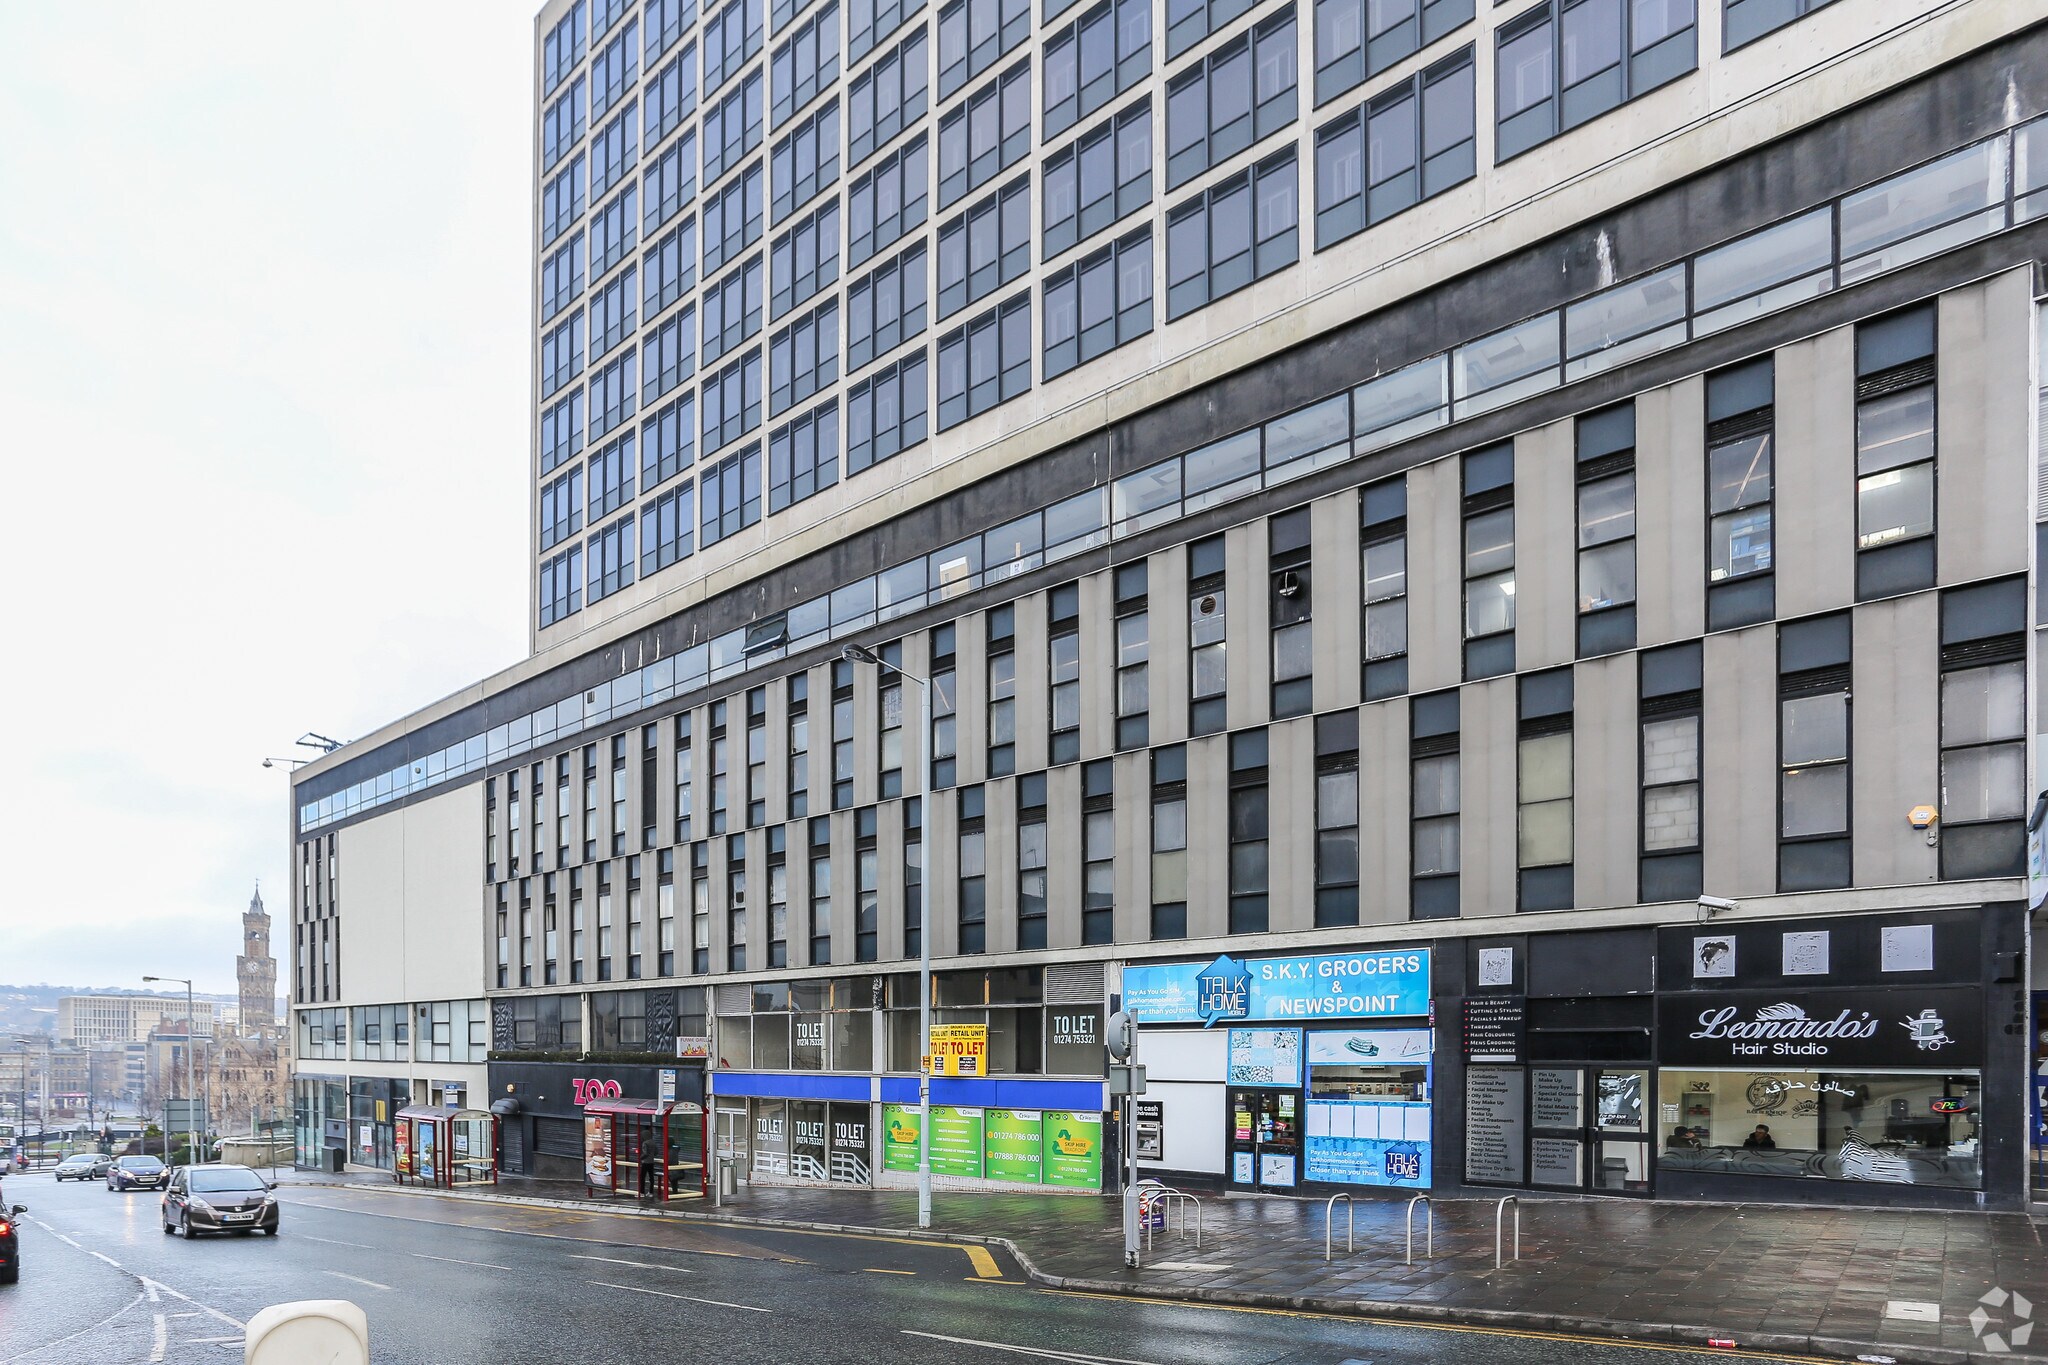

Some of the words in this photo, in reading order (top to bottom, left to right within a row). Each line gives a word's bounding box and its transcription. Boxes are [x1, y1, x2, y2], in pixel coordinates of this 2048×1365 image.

[1262, 963, 1312, 980] S.K.Y.
[1318, 956, 1420, 977] GROCERS
[1202, 976, 1246, 993] TALK
[1331, 981, 1342, 993] &
[1201, 993, 1246, 1010] HOME
[1280, 995, 1399, 1015] NEWSPOINT
[1164, 1009, 1177, 1017] you
[1054, 1016, 1070, 1034] TO
[1073, 1016, 1095, 1034] LET
[1690, 1006, 1879, 1039] Leonardo's
[797, 1023, 807, 1038] TO
[809, 1023, 824, 1038] LET
[1054, 1035, 1071, 1044] 01274
[1073, 1035, 1095, 1044] 753321
[931, 1042, 938, 1055] TO
[938, 1042, 948, 1055] LET
[951, 1042, 964, 1055] TO
[967, 1042, 984, 1055] LET
[1732, 1043, 1768, 1055] Hair
[1773, 1042, 1828, 1055] Studio
[573, 1078, 622, 1105] ZOO
[757, 1119, 766, 1133] TO
[768, 1119, 783, 1134] LET
[796, 1121, 807, 1136] TO
[809, 1122, 823, 1137] LET
[835, 1123, 847, 1138] TO
[848, 1124, 865, 1139] LET
[994, 1131, 1013, 1140] 01274
[1014, 1133, 1026, 1141] 786
[994, 1152, 1014, 1160] 07888
[1388, 1153, 1418, 1164] TALK
[1387, 1164, 1418, 1175] HOME
